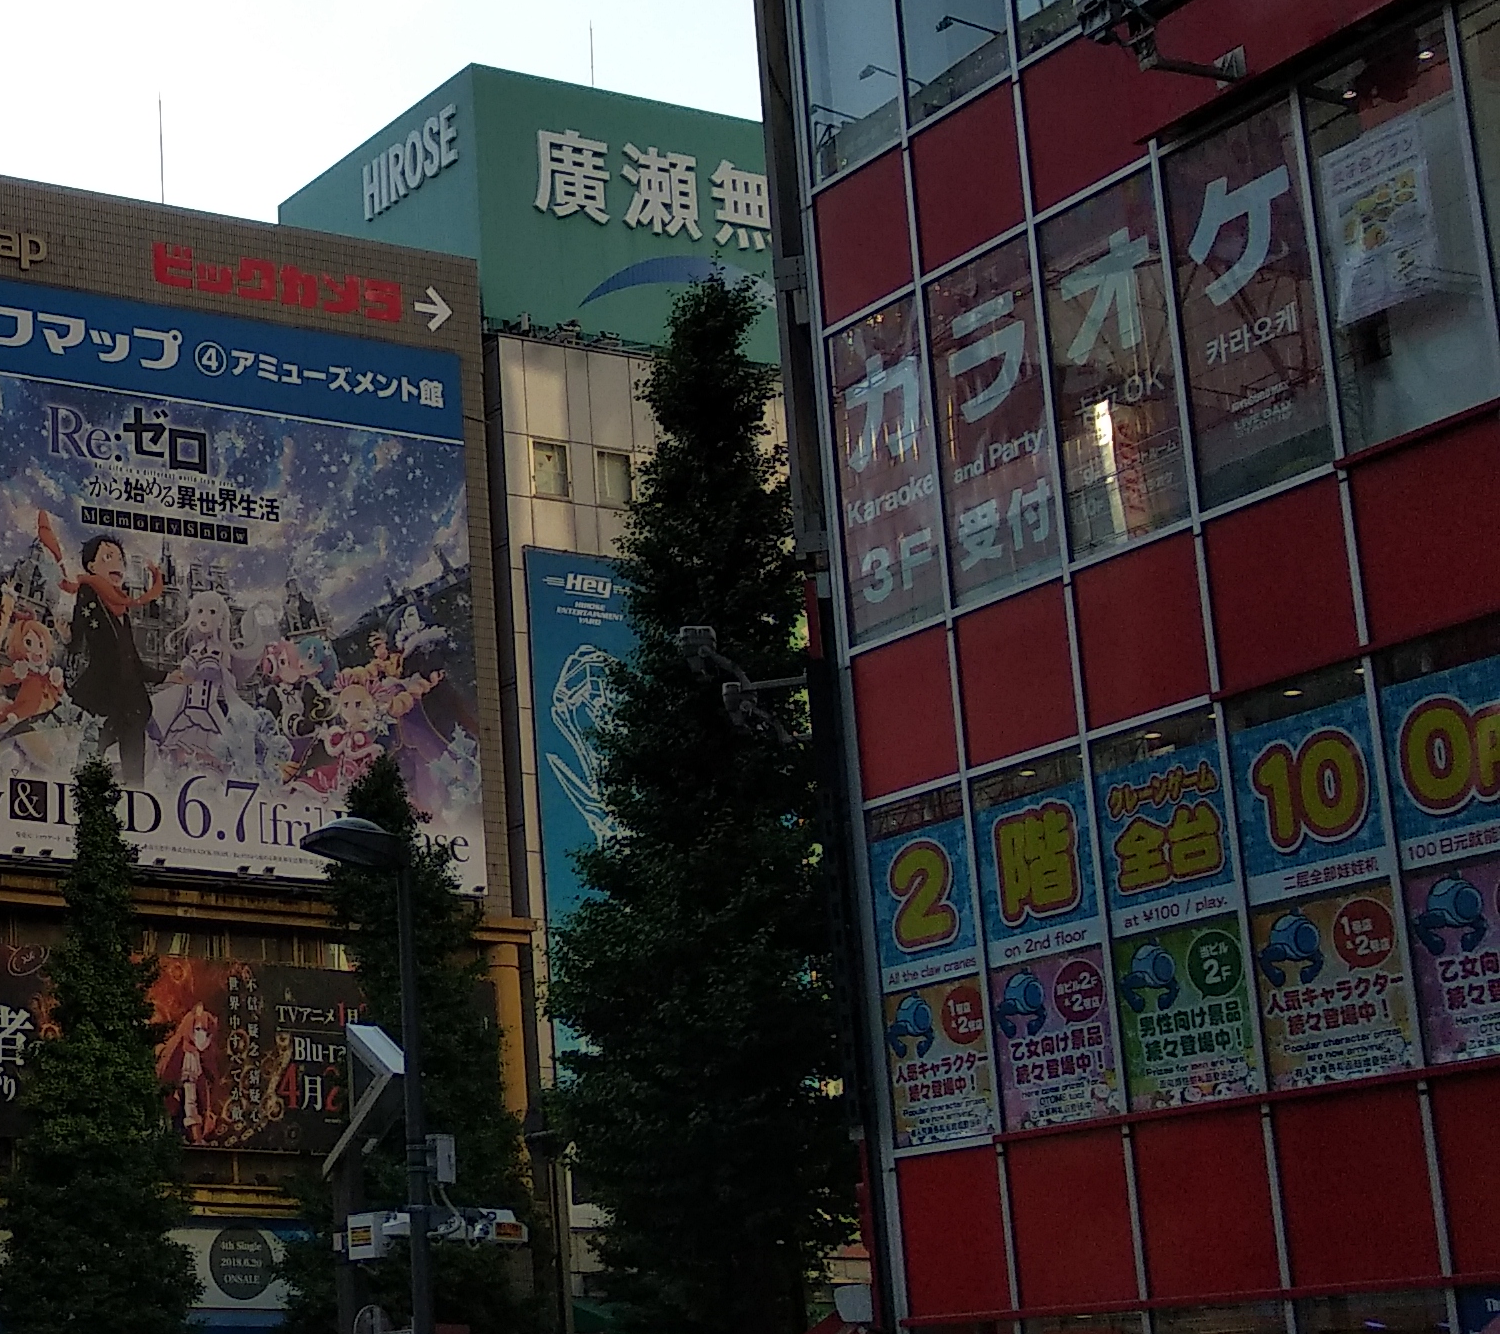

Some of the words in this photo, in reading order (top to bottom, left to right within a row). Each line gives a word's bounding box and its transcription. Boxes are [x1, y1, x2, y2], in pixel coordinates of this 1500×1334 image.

[363, 103, 459, 222] HIROSE
[152, 241, 402, 323] ビックカメラ
[1206, 301, 1299, 366] 카라오케
[89, 475, 280, 523] から始める異世界生活
[846, 474, 935, 529] Karaoke
[953, 452, 985, 485] and
[987, 427, 1045, 474] Party
[860, 527, 933, 604] 3F
[958, 478, 1052, 573] 受付
[565, 573, 612, 598] Hey
[13, 780, 45, 820] &
[53, 781, 162, 833] DD
[1108, 761, 1219, 819] クレーンゲーム
[1114, 799, 1227, 895] 全台
[1125, 916, 1139, 928] at
[1143, 903, 1179, 923] ¥100
[1005, 944, 1021, 958] on
[1025, 937, 1050, 954] 2nd
[1053, 927, 1088, 949] floor
[888, 973, 901, 986] All
[904, 969, 918, 981] the
[921, 965, 941, 977] claw
[944, 958, 977, 973] cranes
[1203, 959, 1232, 985] 2F
[1322, 1034, 1371, 1048] character
